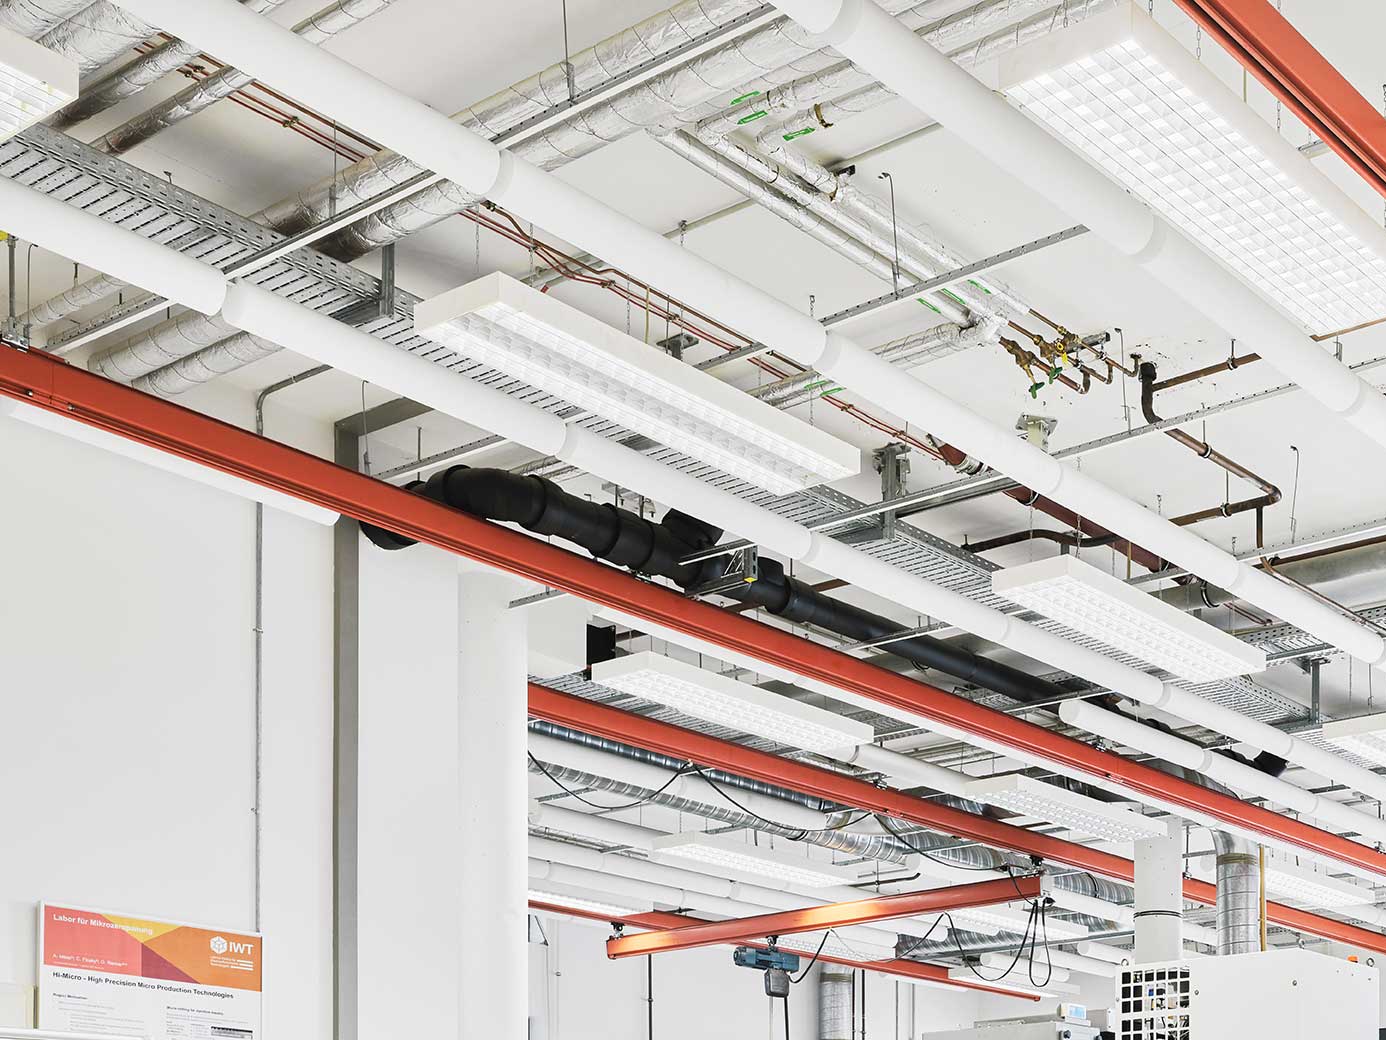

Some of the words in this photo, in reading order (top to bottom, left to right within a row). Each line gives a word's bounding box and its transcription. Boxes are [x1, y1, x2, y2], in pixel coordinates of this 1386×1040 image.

[52, 914, 76, 922] Labor
[77, 917, 89, 925] für
[229, 941, 254, 955] IWT
[52, 972, 82, 981] Hi-Micro
[88, 975, 104, 985] High
[105, 977, 137, 988] Precision
[138, 981, 156, 990] Micro
[156, 984, 192, 994] Production
[193, 988, 234, 999] Technologies
